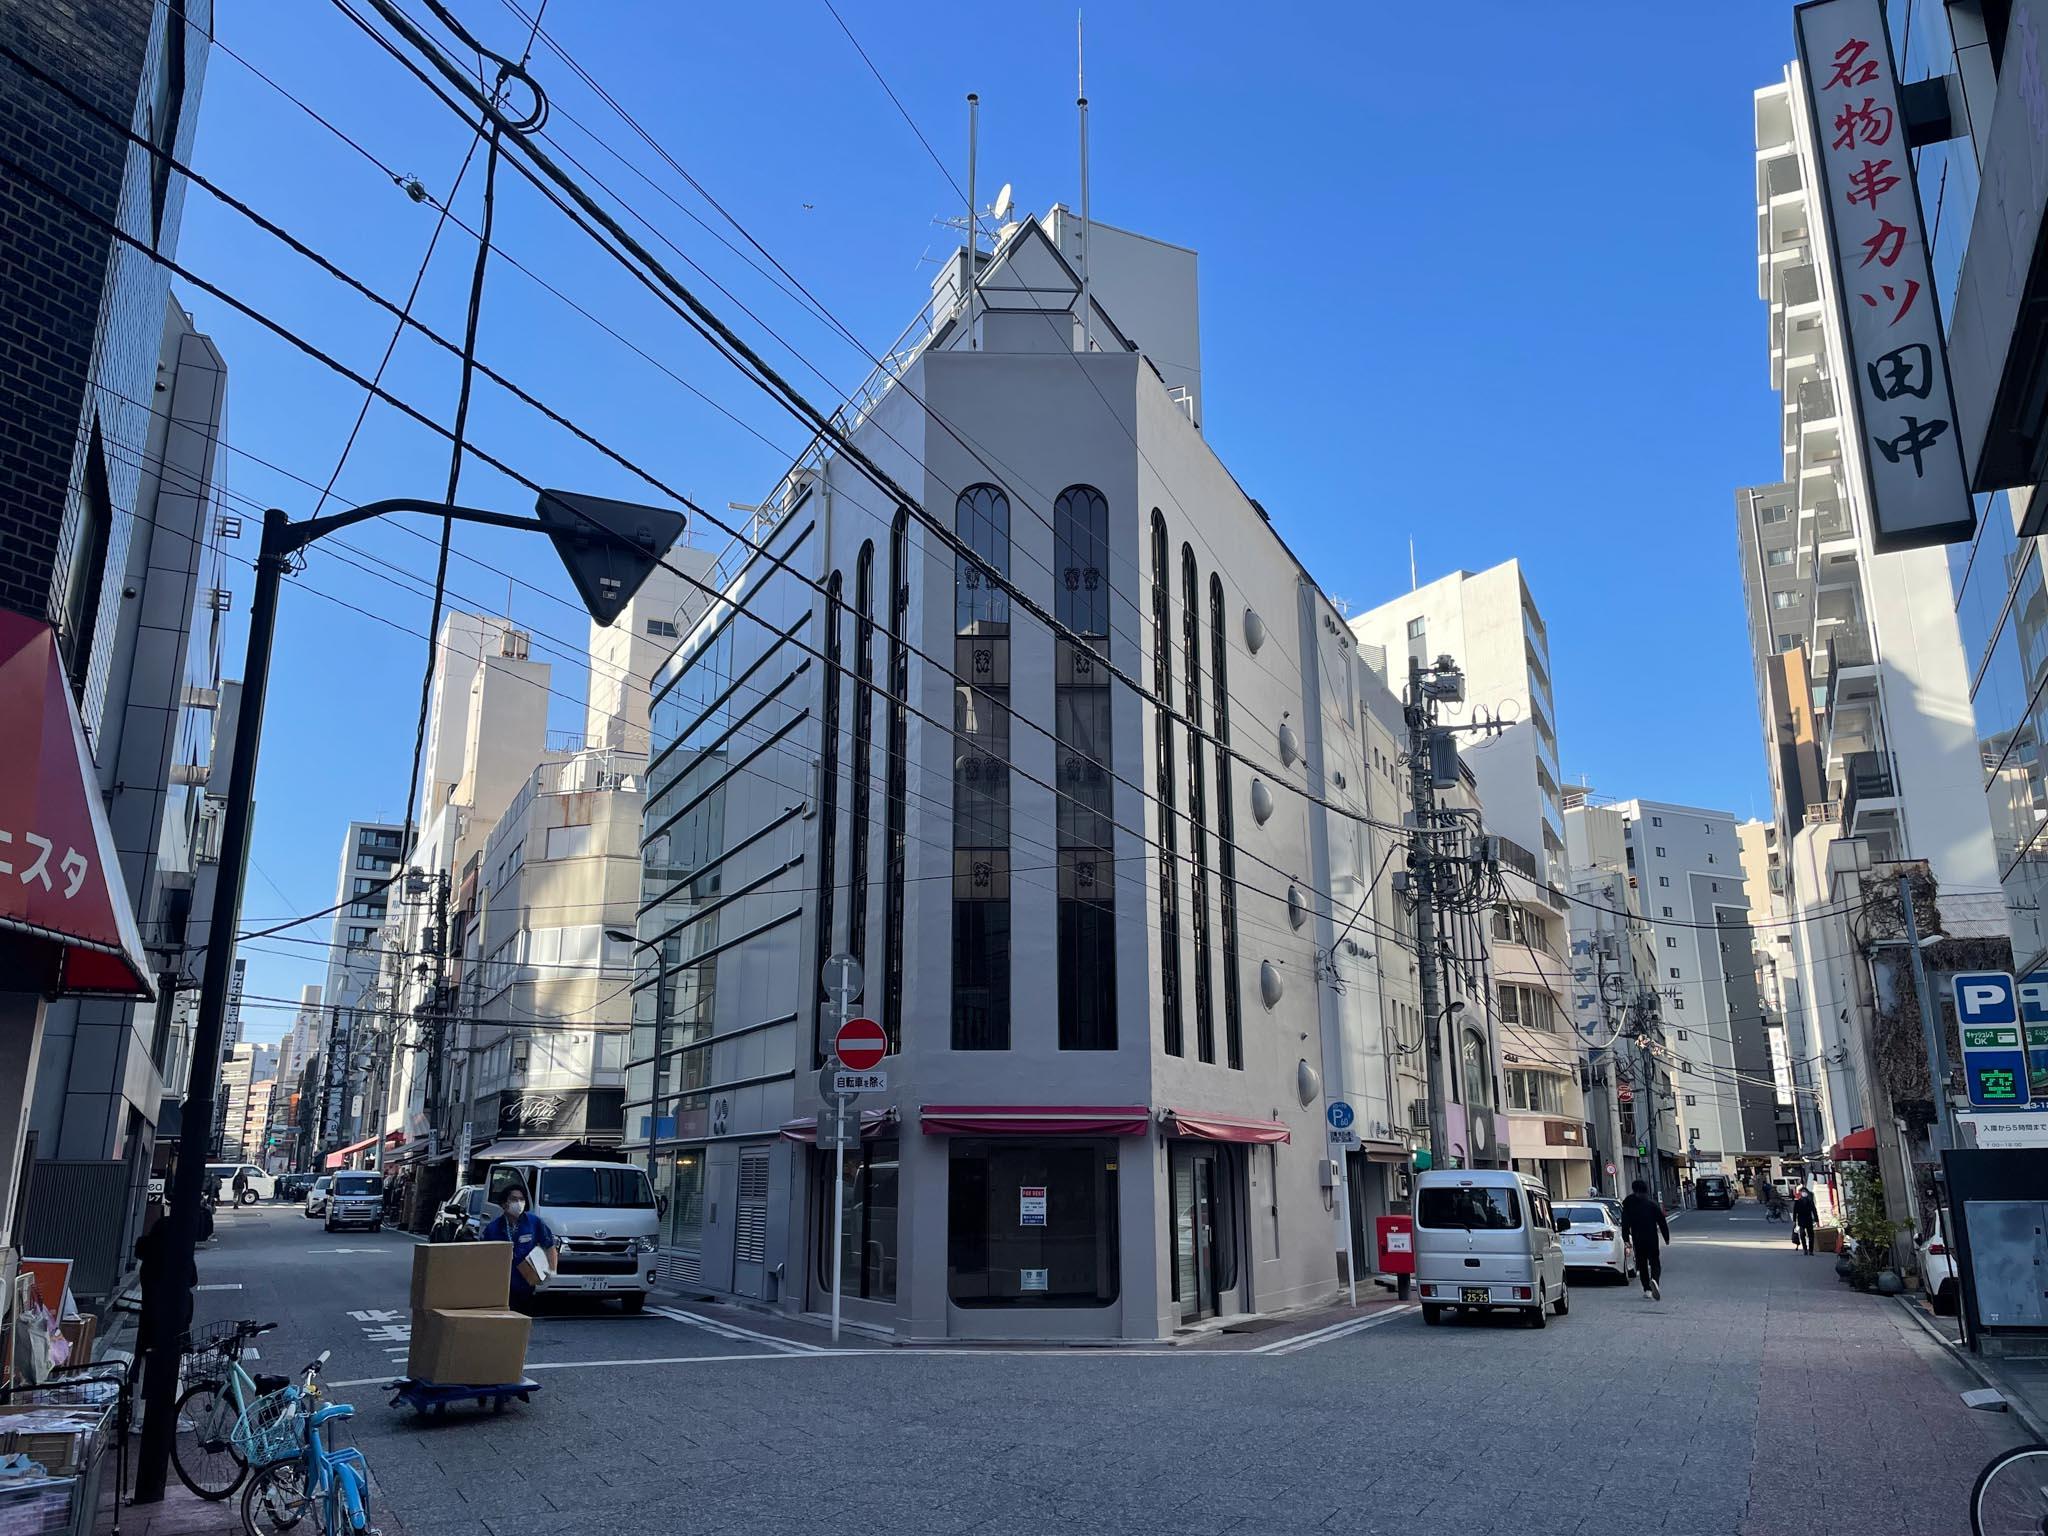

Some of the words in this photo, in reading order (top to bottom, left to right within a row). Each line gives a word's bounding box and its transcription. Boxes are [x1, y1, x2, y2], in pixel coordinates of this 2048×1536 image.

[1963, 984, 2006, 1015] P
[1966, 1031, 1994, 1039] キャッシュレス
[1974, 1037, 1988, 1045] OK
[837, 1076, 884, 1088] 自転車を除く
[1980, 1070, 2016, 1098] 空
[1333, 1109, 1343, 1126] P
[1467, 1294, 1488, 1302] 25-25
